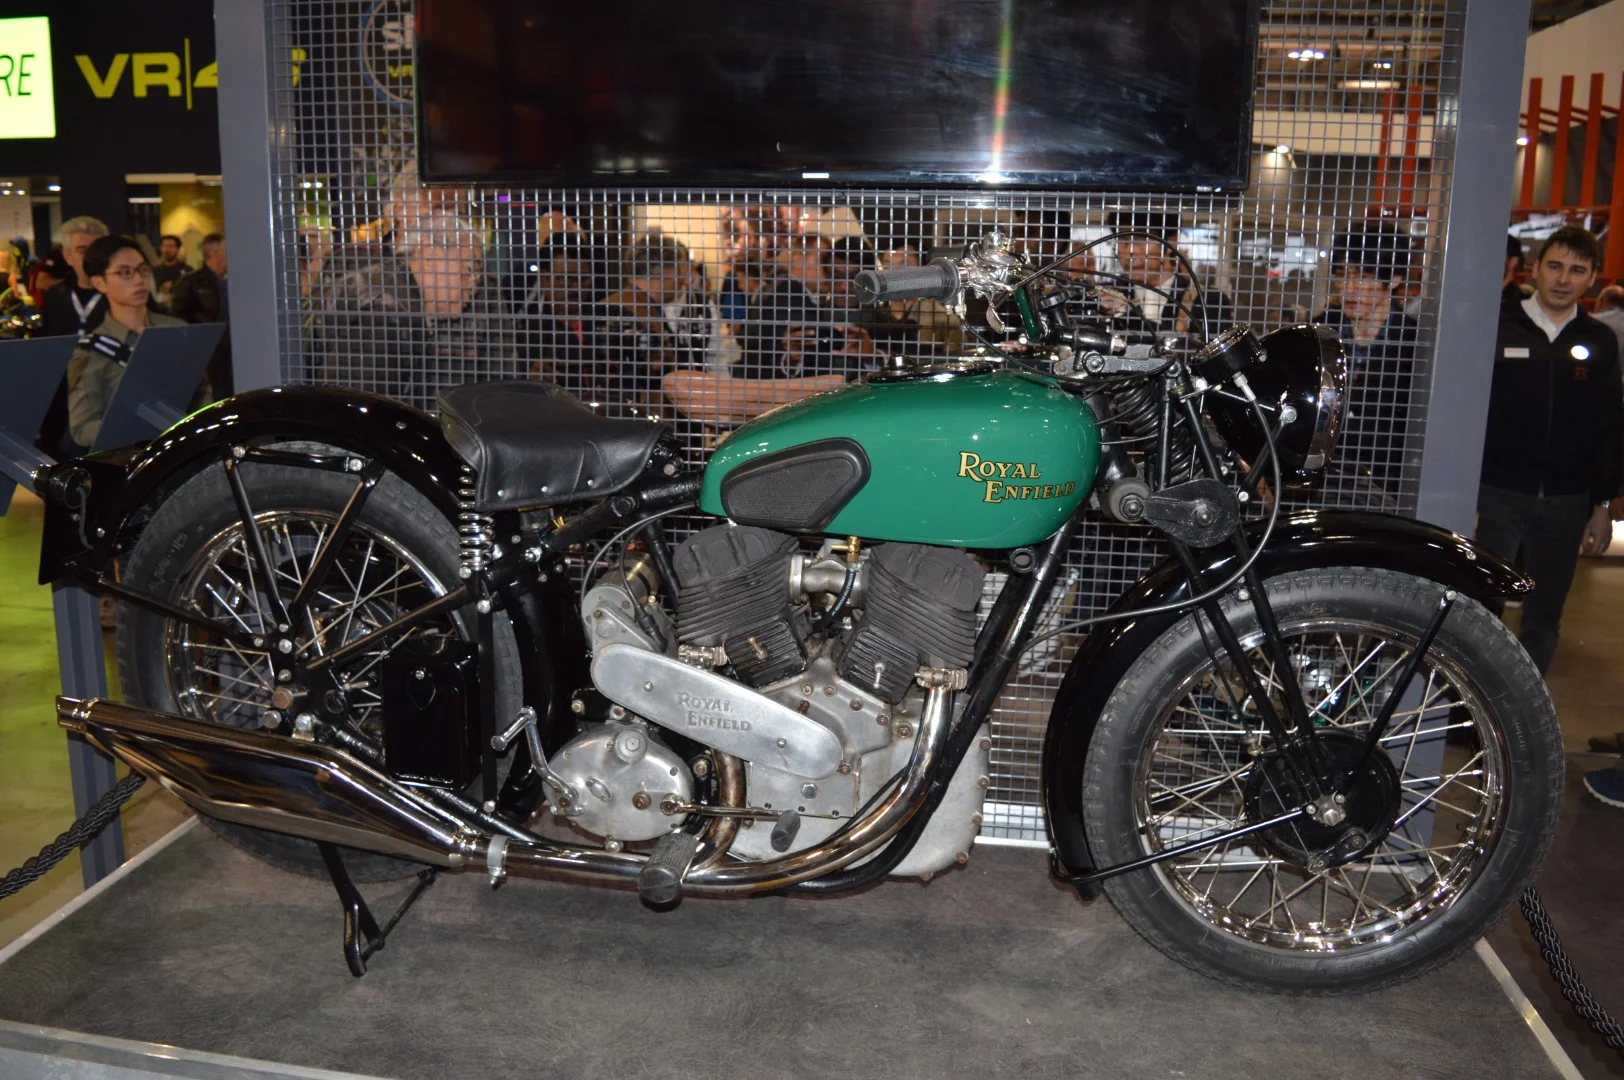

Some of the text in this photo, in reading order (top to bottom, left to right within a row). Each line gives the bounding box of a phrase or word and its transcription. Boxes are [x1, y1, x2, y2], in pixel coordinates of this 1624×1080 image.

[957, 451, 1042, 482] ROYAL
[983, 479, 1076, 504] ENFIELD
[676, 691, 733, 713] ROYAL
[687, 710, 751, 731] ENFIELD
